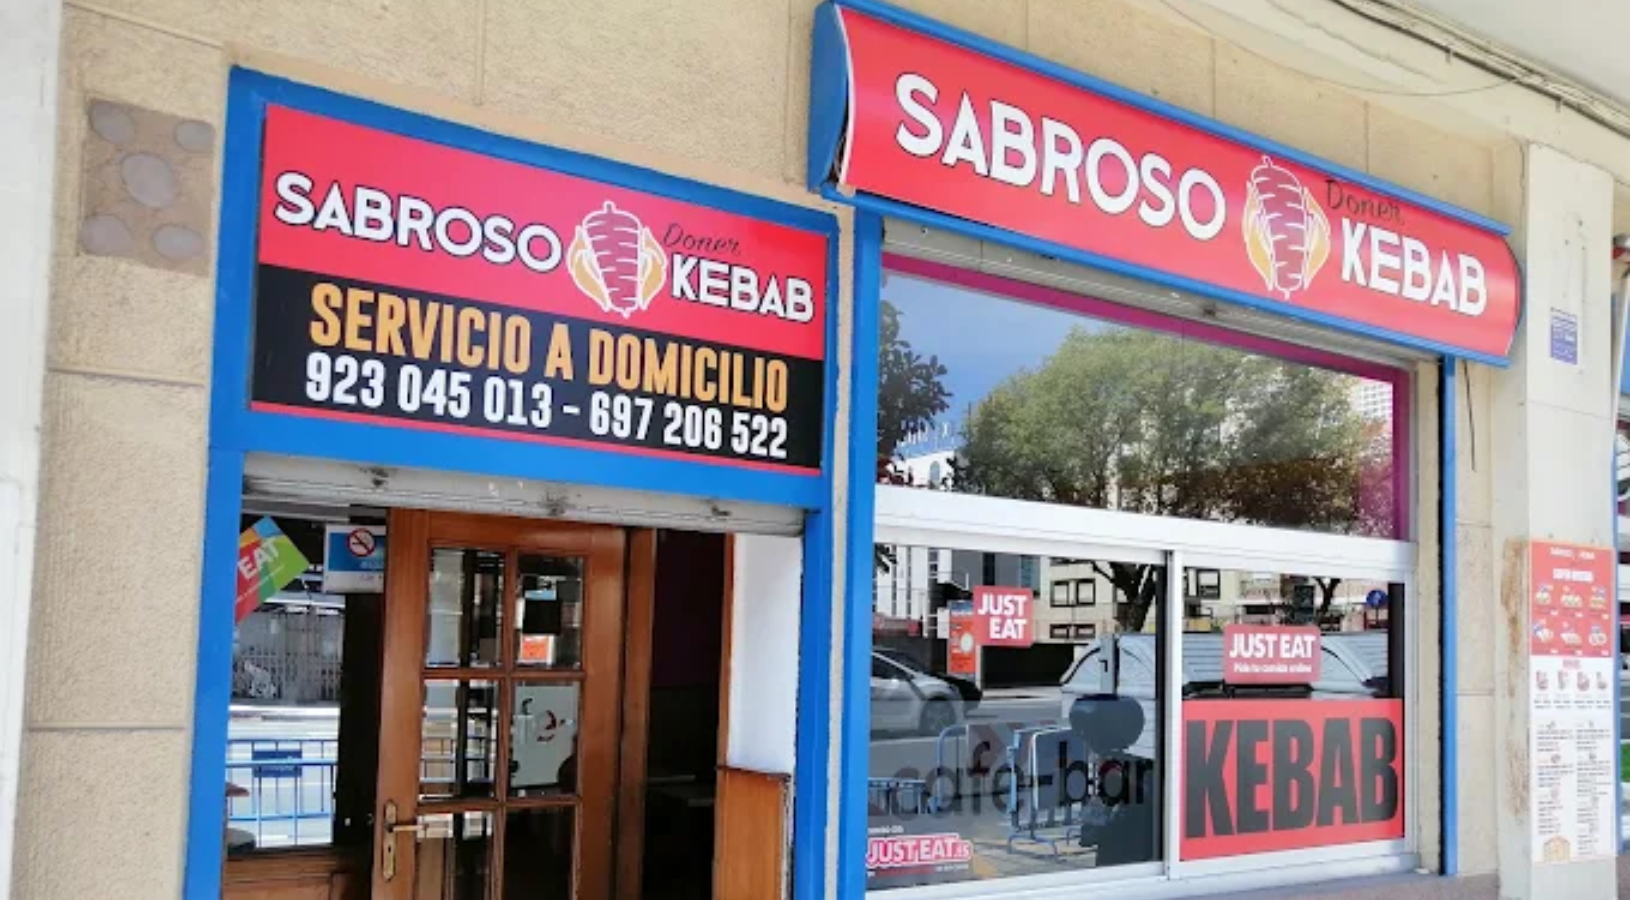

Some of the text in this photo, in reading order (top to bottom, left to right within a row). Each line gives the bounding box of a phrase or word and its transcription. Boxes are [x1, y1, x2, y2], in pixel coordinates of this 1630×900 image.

[895, 72, 1226, 241] SABROSO
[274, 172, 563, 273] SABROSO
[1325, 178, 1405, 226] Doner
[663, 223, 741, 257] Doner
[1340, 217, 1487, 317] KEBAB
[671, 252, 814, 323] KEBAB
[309, 283, 789, 413] SERVICIO A DOMICILIO
[305, 352, 788, 459] 923 045 013 - 697 206 522
[237, 537, 280, 580] EAT
[977, 592, 1027, 617] JUST
[989, 616, 1027, 640] EAT
[1229, 633, 1316, 658] JUST EAT
[1184, 716, 1399, 839] KEBAB
